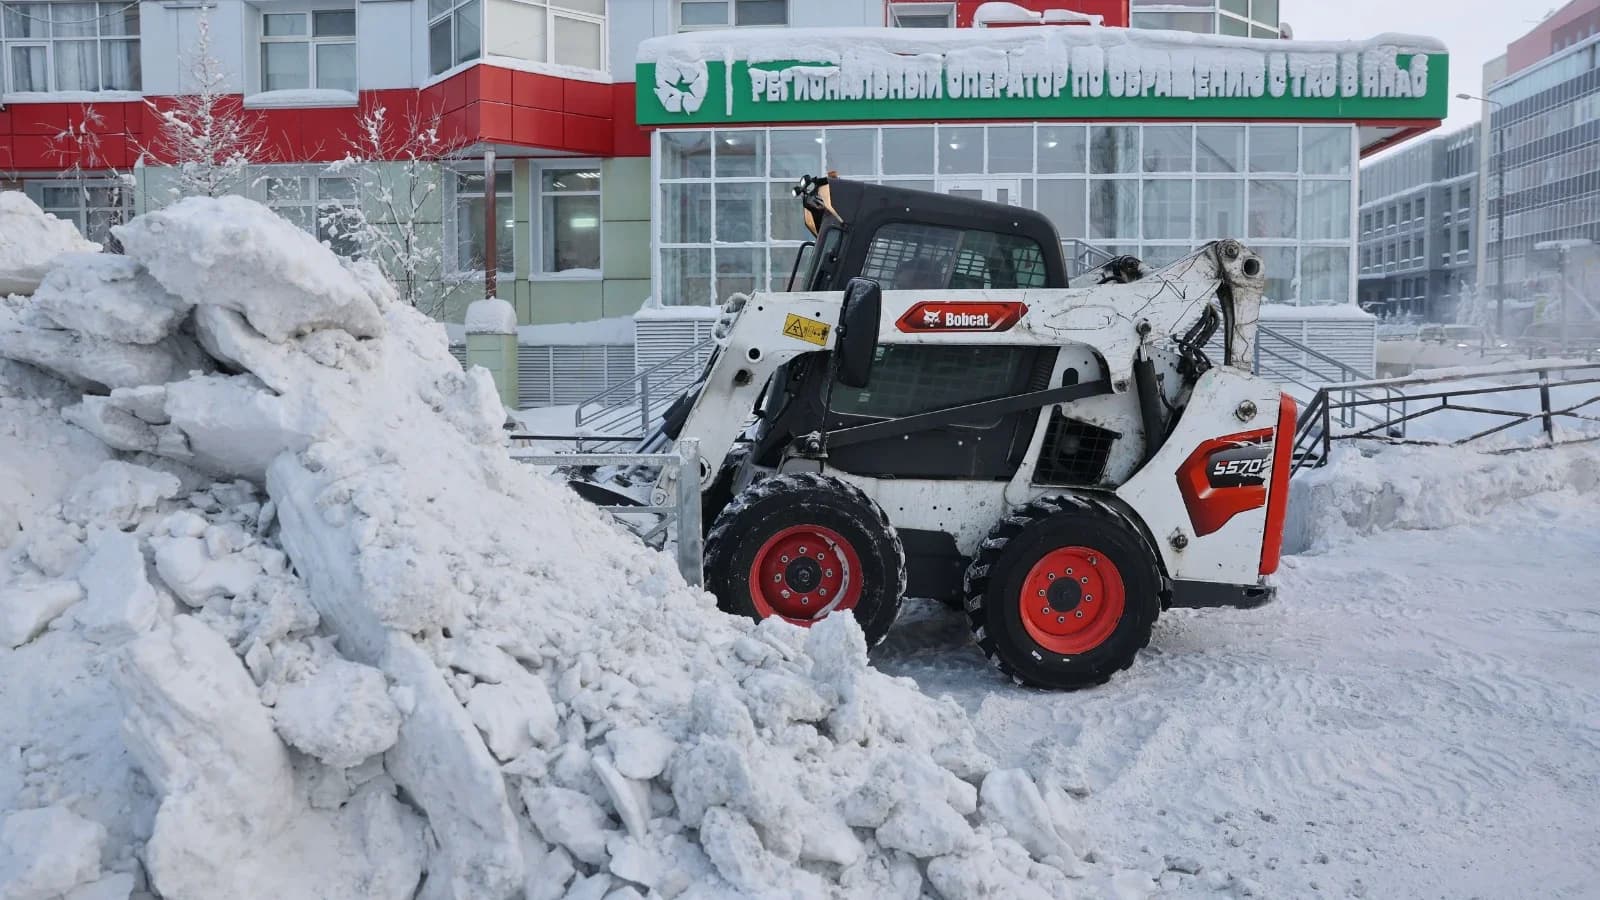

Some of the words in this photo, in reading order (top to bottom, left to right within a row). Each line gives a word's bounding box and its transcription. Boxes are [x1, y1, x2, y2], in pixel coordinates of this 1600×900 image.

[947, 65, 1068, 99] ОПЕРАТОР
[1072, 65, 1104, 98] ПО
[1289, 63, 1337, 98] ТКО
[1340, 63, 1359, 98] В
[945, 312, 989, 327] Bobcat
[1213, 459, 1262, 476] S570
